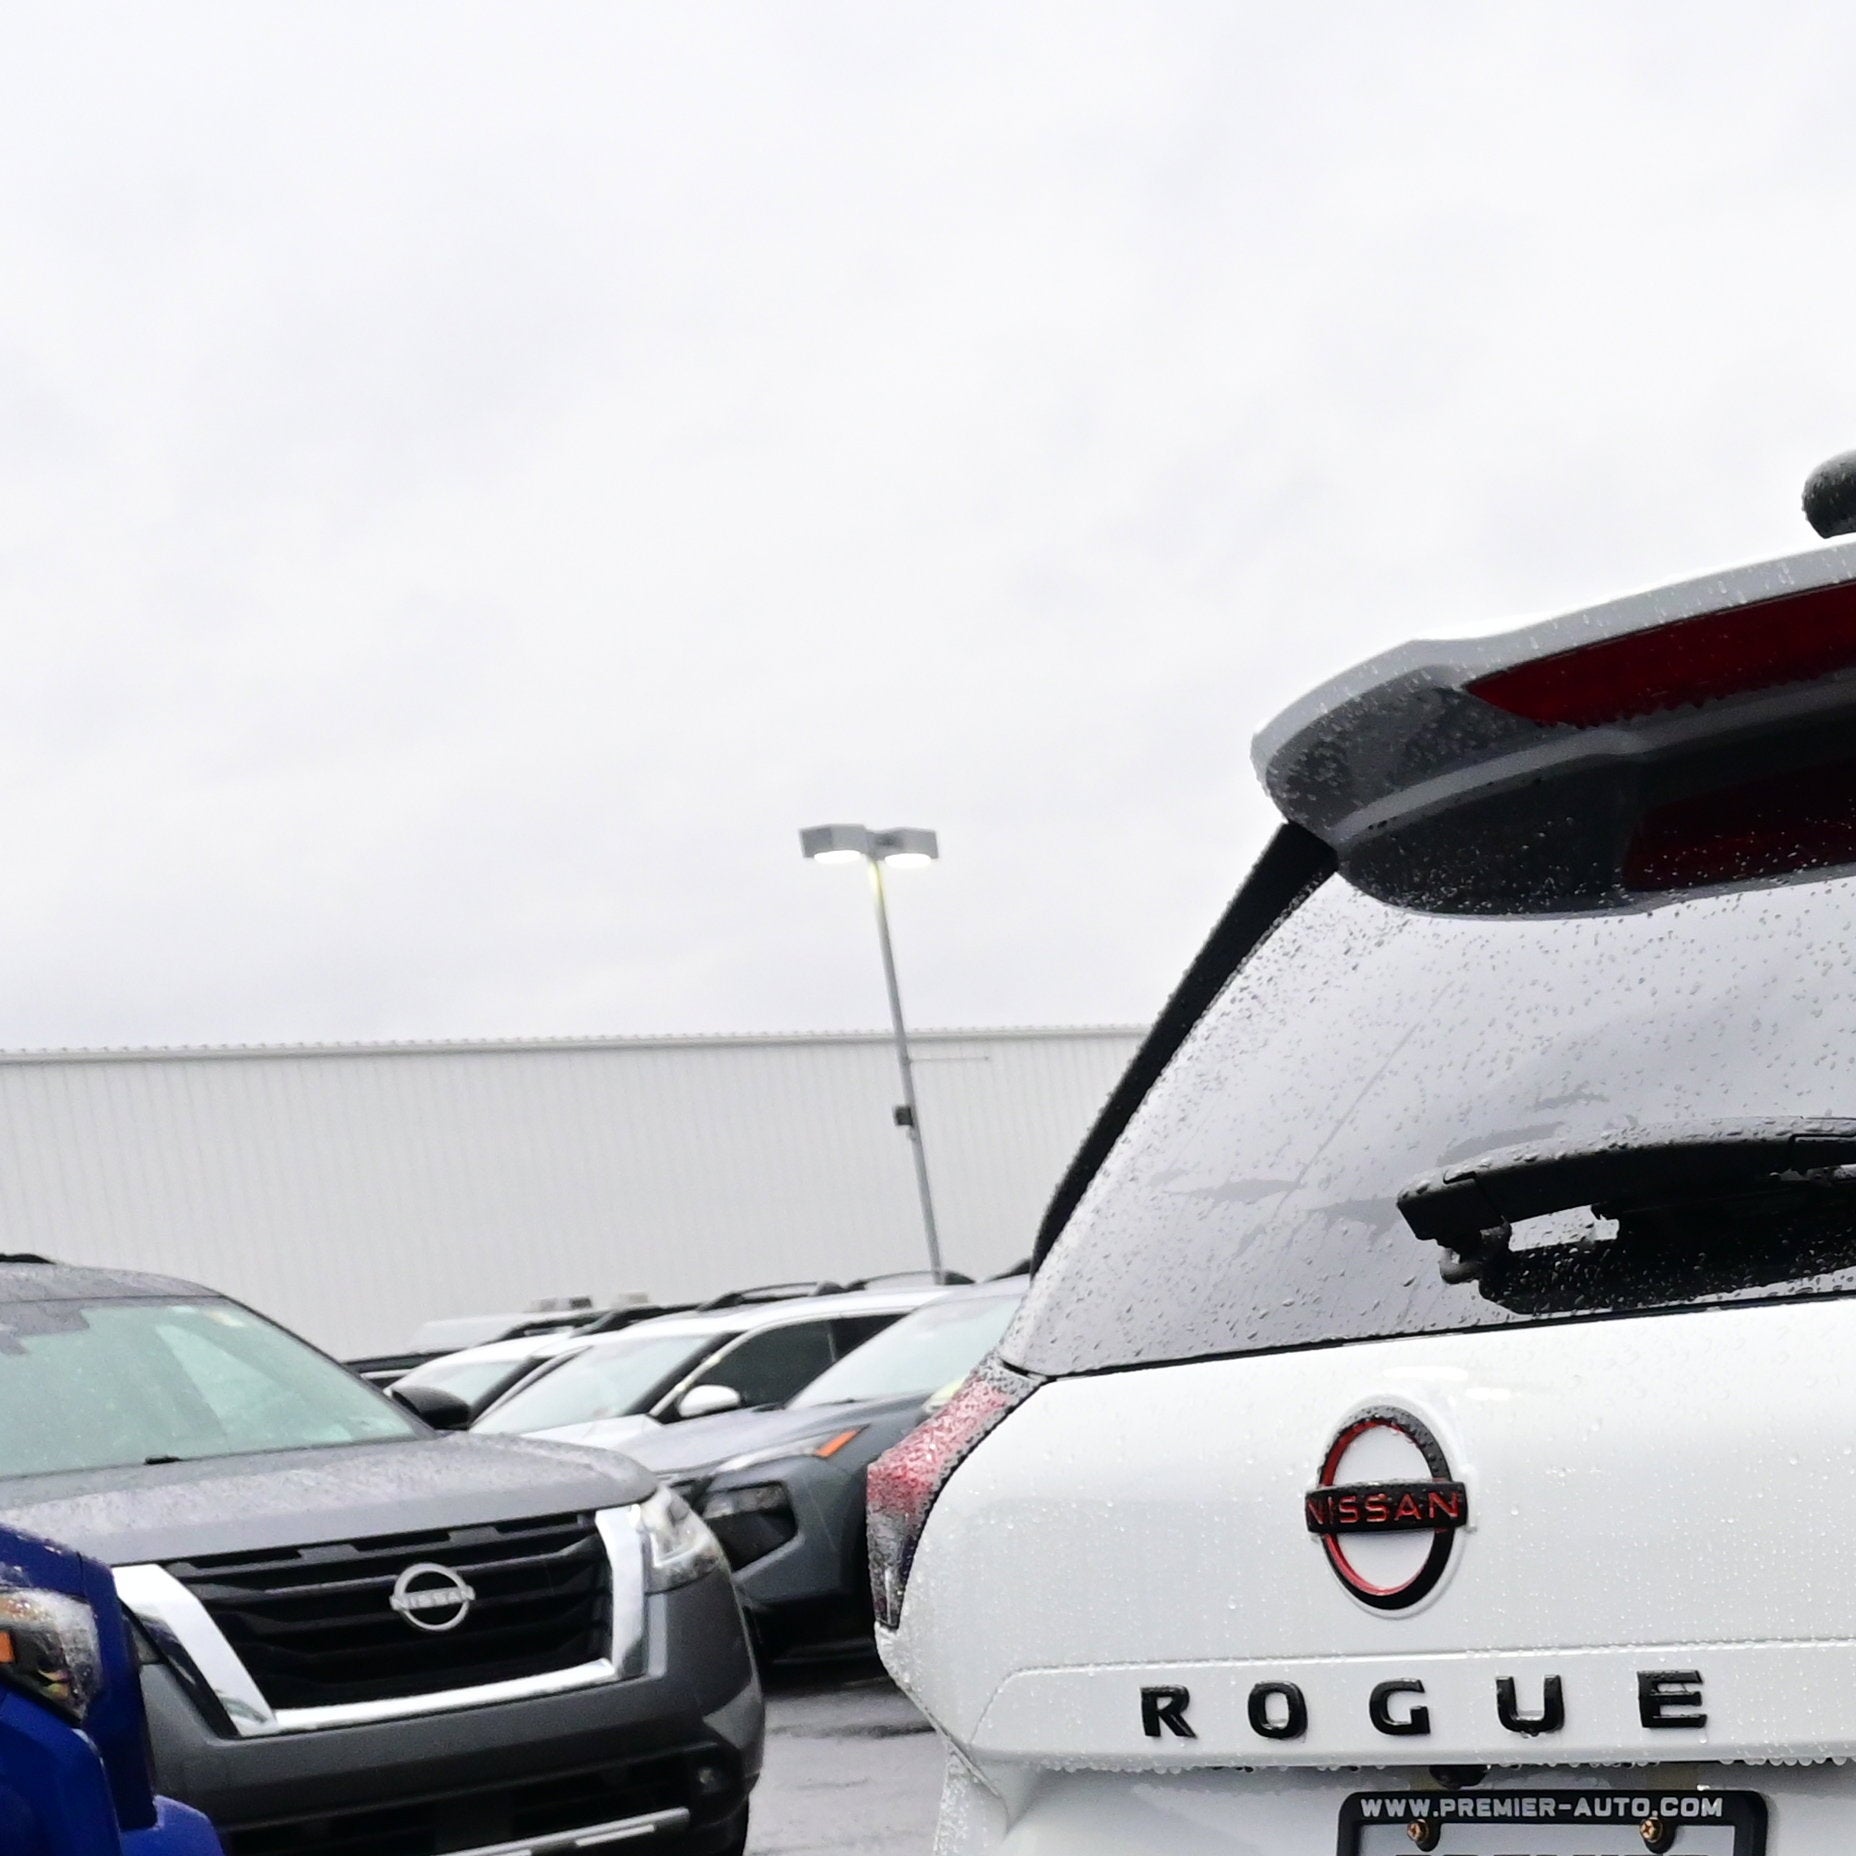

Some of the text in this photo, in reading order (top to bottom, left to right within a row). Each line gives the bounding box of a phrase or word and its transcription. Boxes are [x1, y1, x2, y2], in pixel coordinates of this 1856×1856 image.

[1307, 1491, 1462, 1525] NISSAN
[1140, 1668, 1707, 1740] ROGUE
[1361, 1797, 1723, 1818] WWW.PREMIER-AUTO.COM
